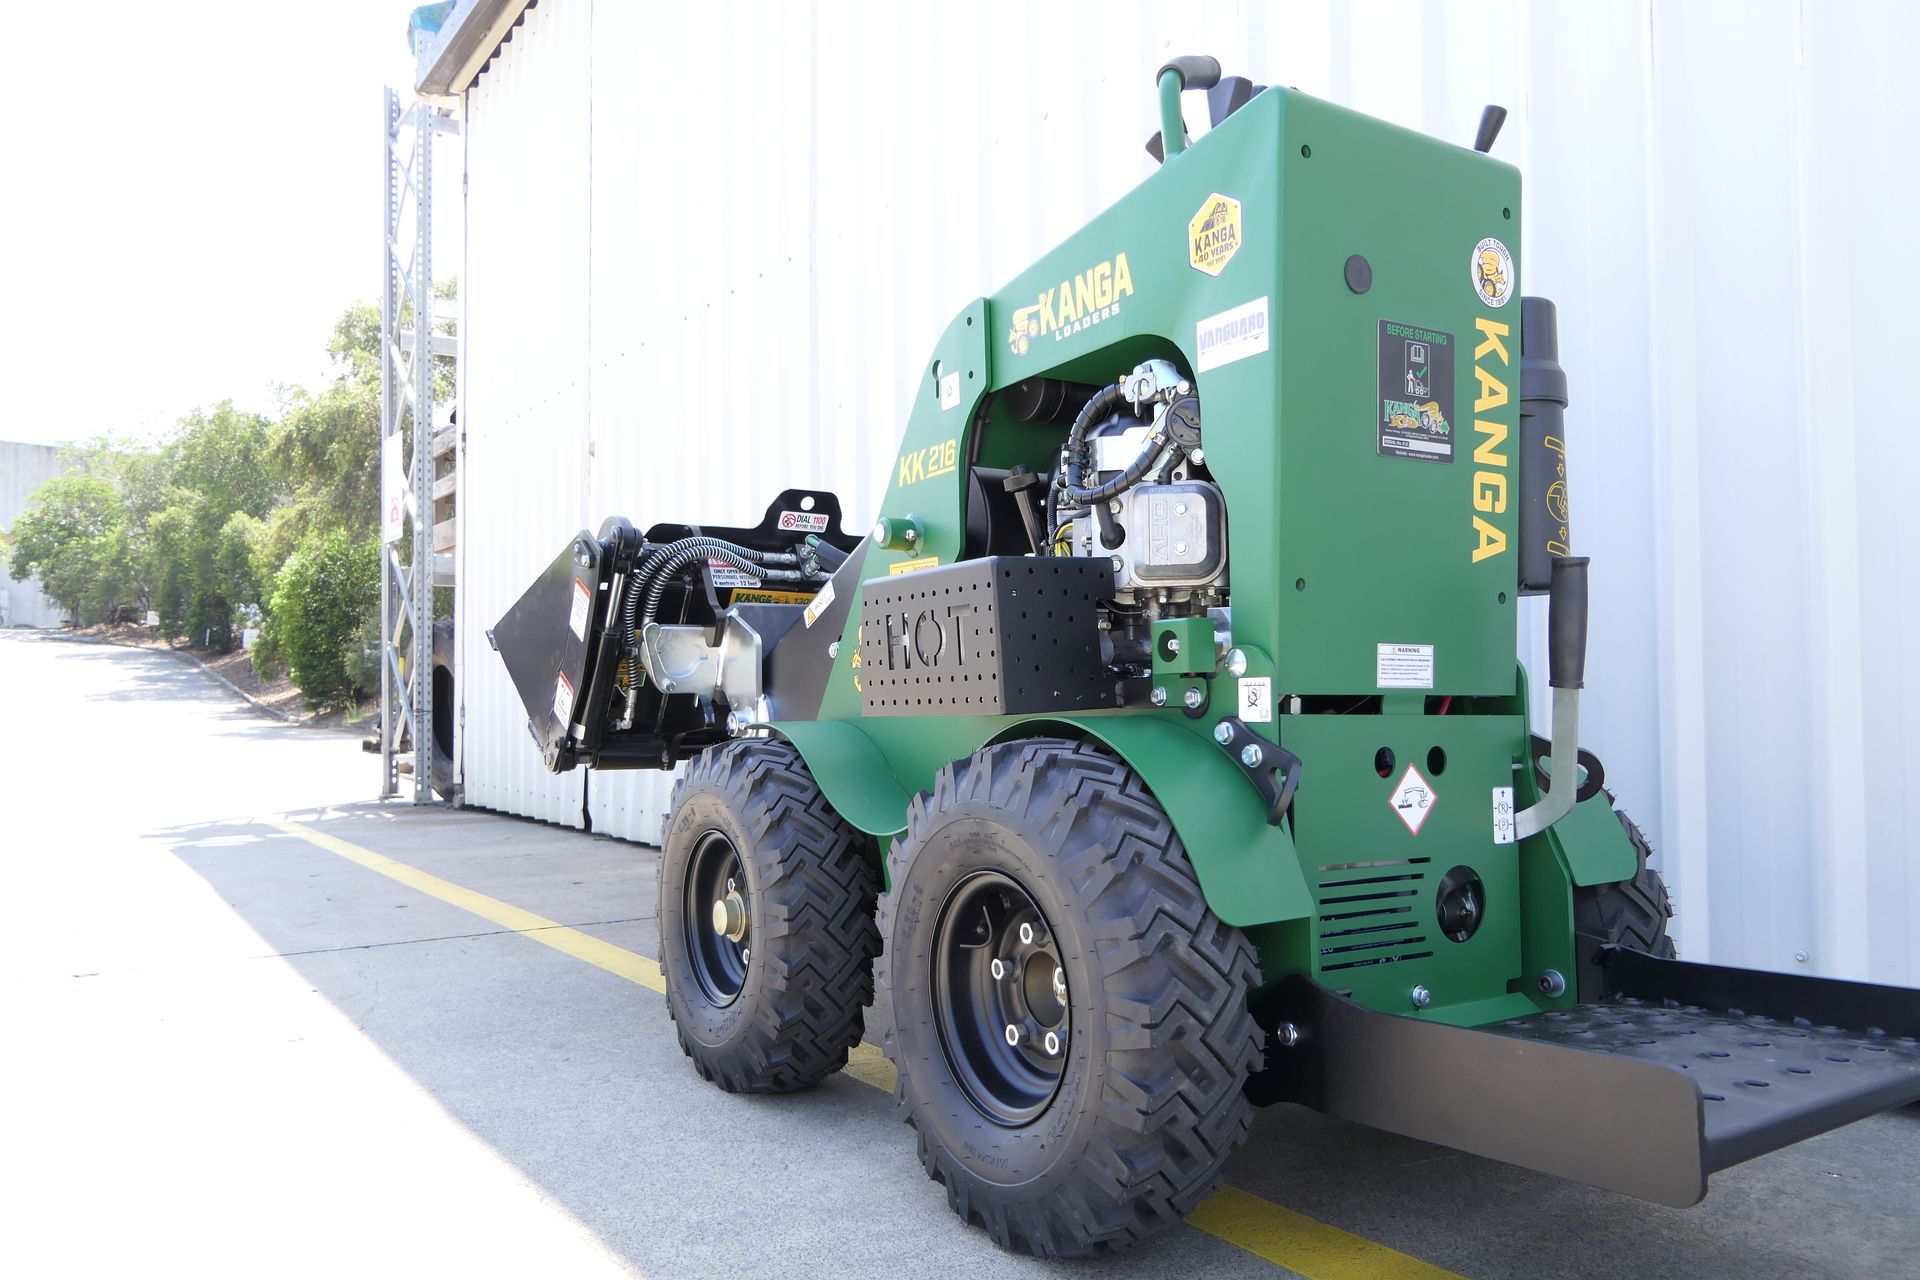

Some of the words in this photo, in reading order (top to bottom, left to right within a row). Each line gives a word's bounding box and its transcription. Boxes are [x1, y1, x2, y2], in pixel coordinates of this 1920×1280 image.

[1195, 223, 1236, 257] KANGA
[1211, 241, 1234, 258] YEARS
[1477, 239, 1491, 253] BUILT
[1493, 240, 1510, 261] TOUGH
[1039, 251, 1135, 337] KANGA
[1479, 289, 1495, 306] SINCE
[1055, 302, 1121, 341] LOADERS
[1199, 311, 1265, 351] VANGUARD
[1387, 324, 1415, 339] BEFORE
[1415, 328, 1447, 345] STARTING
[1384, 400, 1422, 426] KANGA
[1472, 317, 1510, 564] KANGA
[898, 448, 928, 488] KK
[927, 438, 957, 473] 216
[796, 514, 811, 524] DIAL
[813, 516, 827, 525] 1100
[735, 592, 773, 604] KANGA
[886, 603, 970, 670] HOT
